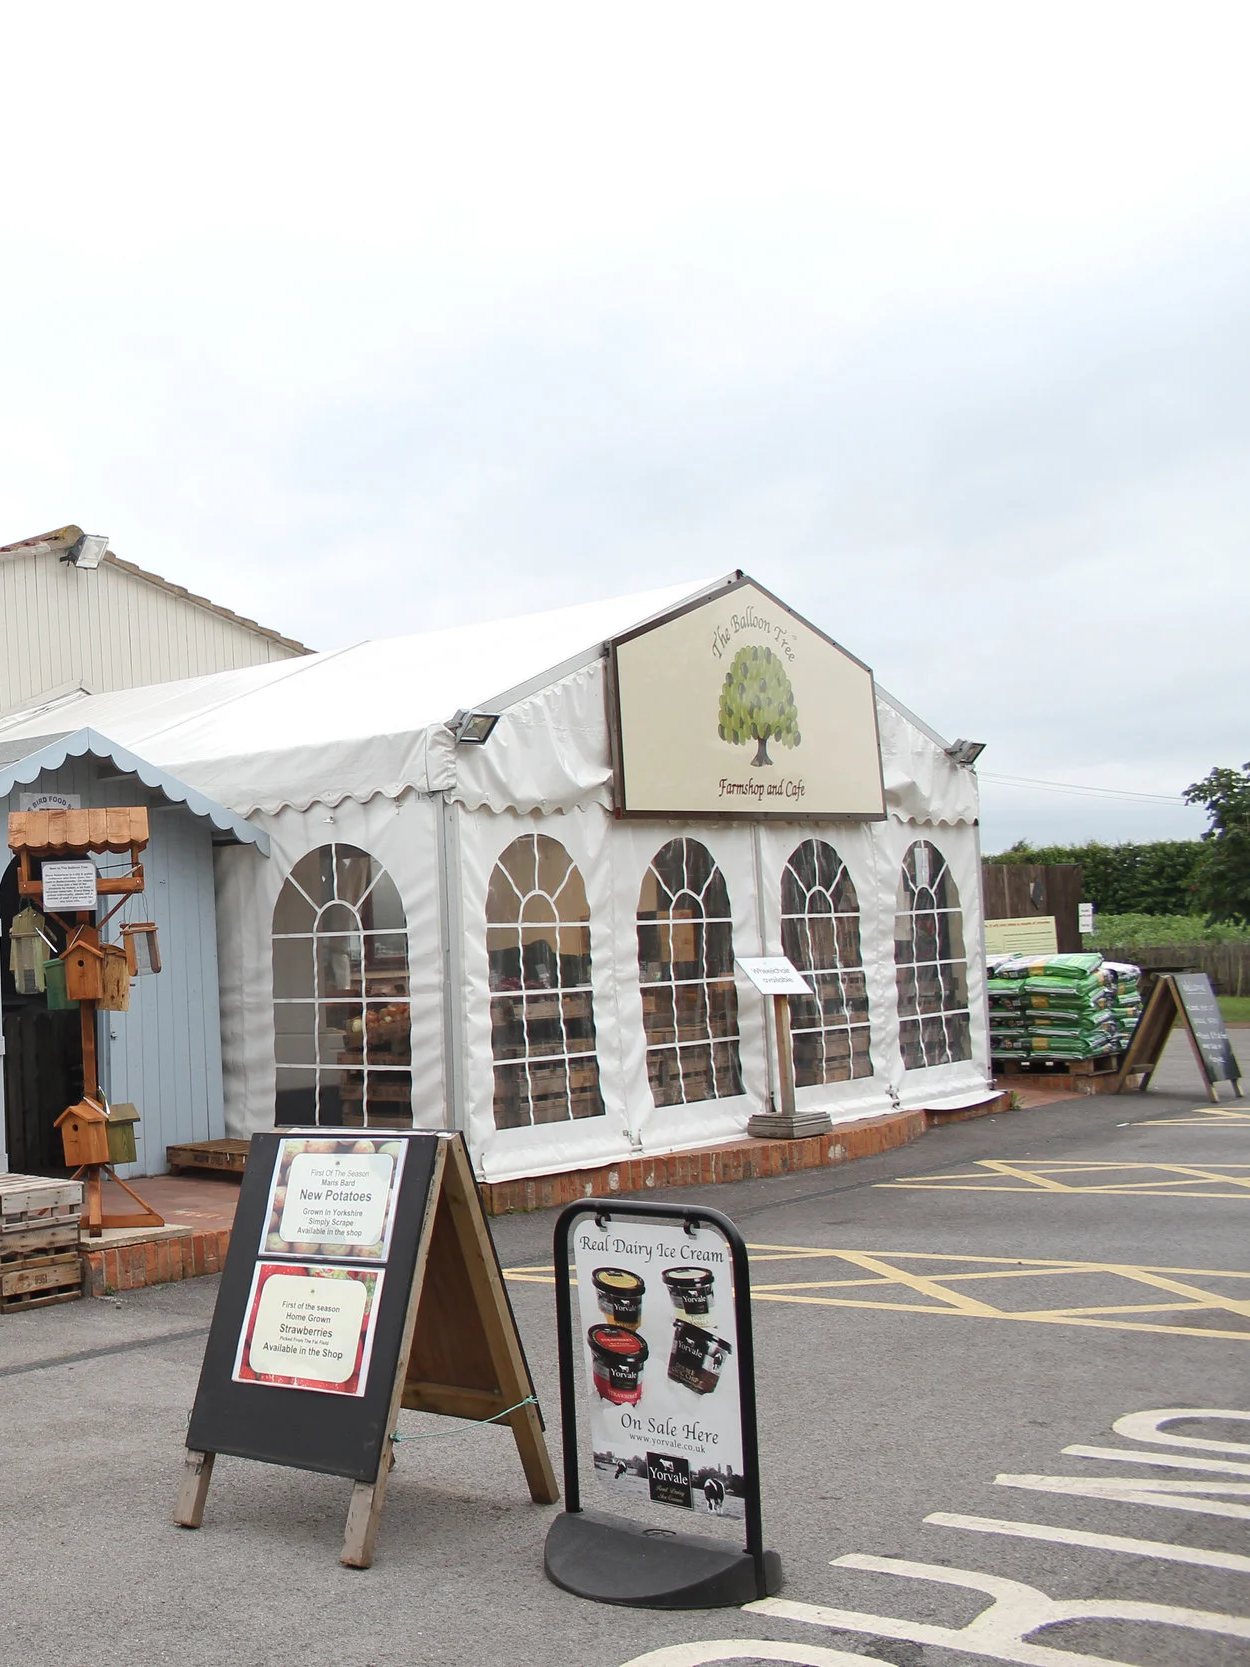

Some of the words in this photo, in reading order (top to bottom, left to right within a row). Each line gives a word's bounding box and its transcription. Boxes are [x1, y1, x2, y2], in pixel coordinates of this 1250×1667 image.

[712, 625, 731, 659] The
[731, 605, 770, 634] Balloon
[774, 626, 795, 662] Tree
[718, 777, 765, 801] Farmshop
[766, 778, 784, 796] and
[785, 779, 805, 802] Cafe
[32, 796, 47, 809] BIRD
[49, 796, 67, 806] FOOD
[311, 1168, 325, 1177] First
[325, 1169, 333, 1177] Of
[347, 1170, 370, 1178] Season
[340, 1179, 356, 1187] Bard
[299, 1189, 323, 1200] New
[325, 1189, 372, 1202] Potatoes
[302, 1207, 323, 1215] Grown
[332, 1208, 363, 1216] Yorkshire
[308, 1217, 330, 1227] Simply
[331, 1218, 354, 1228] Scrape
[297, 1226, 326, 1235] Available
[327, 1228, 333, 1236] in
[334, 1228, 345, 1236] the
[346, 1229, 363, 1238] shop
[579, 1234, 611, 1252] Real
[612, 1238, 653, 1263] Dairy
[656, 1243, 676, 1259] Ice
[680, 1244, 724, 1263] Cream
[682, 1295, 706, 1303] Yorvale
[281, 1300, 296, 1309] First
[297, 1301, 305, 1310] of
[305, 1303, 315, 1311] the
[316, 1305, 340, 1313] season
[614, 1303, 637, 1312] Yorvale
[286, 1311, 306, 1321] Home
[307, 1313, 331, 1324] Grown
[279, 1323, 333, 1338] Strawberries
[262, 1341, 298, 1354] Available
[299, 1346, 307, 1355] in
[308, 1347, 320, 1357] the
[322, 1348, 343, 1361] Shop
[678, 1340, 703, 1359] Yorvale
[610, 1367, 638, 1379] Yorvale
[620, 1412, 642, 1430] On
[647, 1417, 677, 1437] Sale
[682, 1421, 719, 1444] Here
[629, 1433, 706, 1453] www.yorvale.co.uk
[649, 1466, 688, 1485] Yorvale
